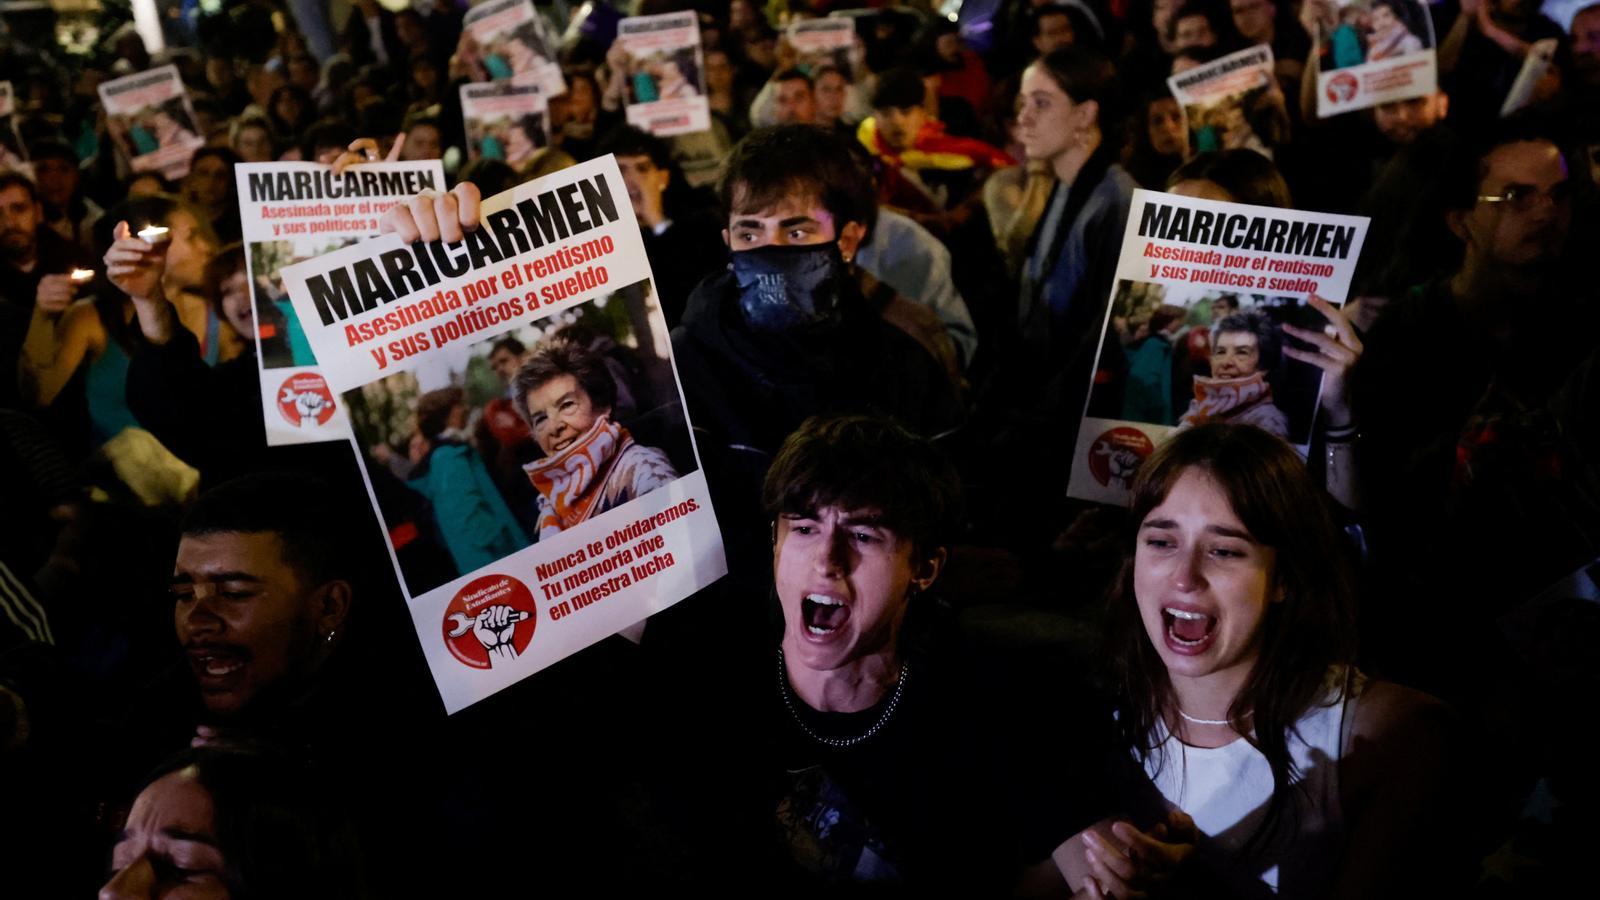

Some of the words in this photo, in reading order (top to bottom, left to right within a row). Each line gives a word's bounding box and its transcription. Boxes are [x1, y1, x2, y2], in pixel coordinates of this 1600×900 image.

[249, 170, 436, 202] MARICARMEN
[262, 203, 333, 220] Asesinada
[334, 204, 356, 218] por
[358, 202, 373, 215] el
[273, 224, 282, 236] y
[284, 222, 308, 235] sus
[369, 218, 379, 230] a
[306, 174, 619, 326] MARICARMEN
[1138, 202, 1356, 259] MARICARMEN
[1142, 242, 1223, 266] Asesinada
[1224, 255, 1251, 269] por
[1252, 256, 1268, 271] el
[1268, 259, 1334, 278] rentismo
[1150, 264, 1161, 279] y
[1162, 265, 1188, 281] sus
[1190, 269, 1255, 287] políticos
[1256, 276, 1267, 288] a
[1268, 278, 1318, 295] sueldo
[344, 289, 464, 348] Asesinada
[461, 274, 500, 307] por
[500, 263, 524, 291] el
[522, 234, 616, 283] rentismo
[370, 346, 389, 371] y
[387, 332, 432, 361] sus
[432, 296, 525, 350] políticos
[524, 290, 542, 311] a
[540, 266, 609, 305] sueldo
[535, 547, 587, 582] Nunca
[585, 539, 605, 559] te
[605, 498, 699, 552] olvidaremos.
[540, 581, 564, 601] Tu
[563, 549, 633, 593] memoria
[632, 535, 665, 559] vive
[549, 600, 572, 622] en
[571, 572, 632, 611] nuestra
[631, 552, 676, 583] lucha
